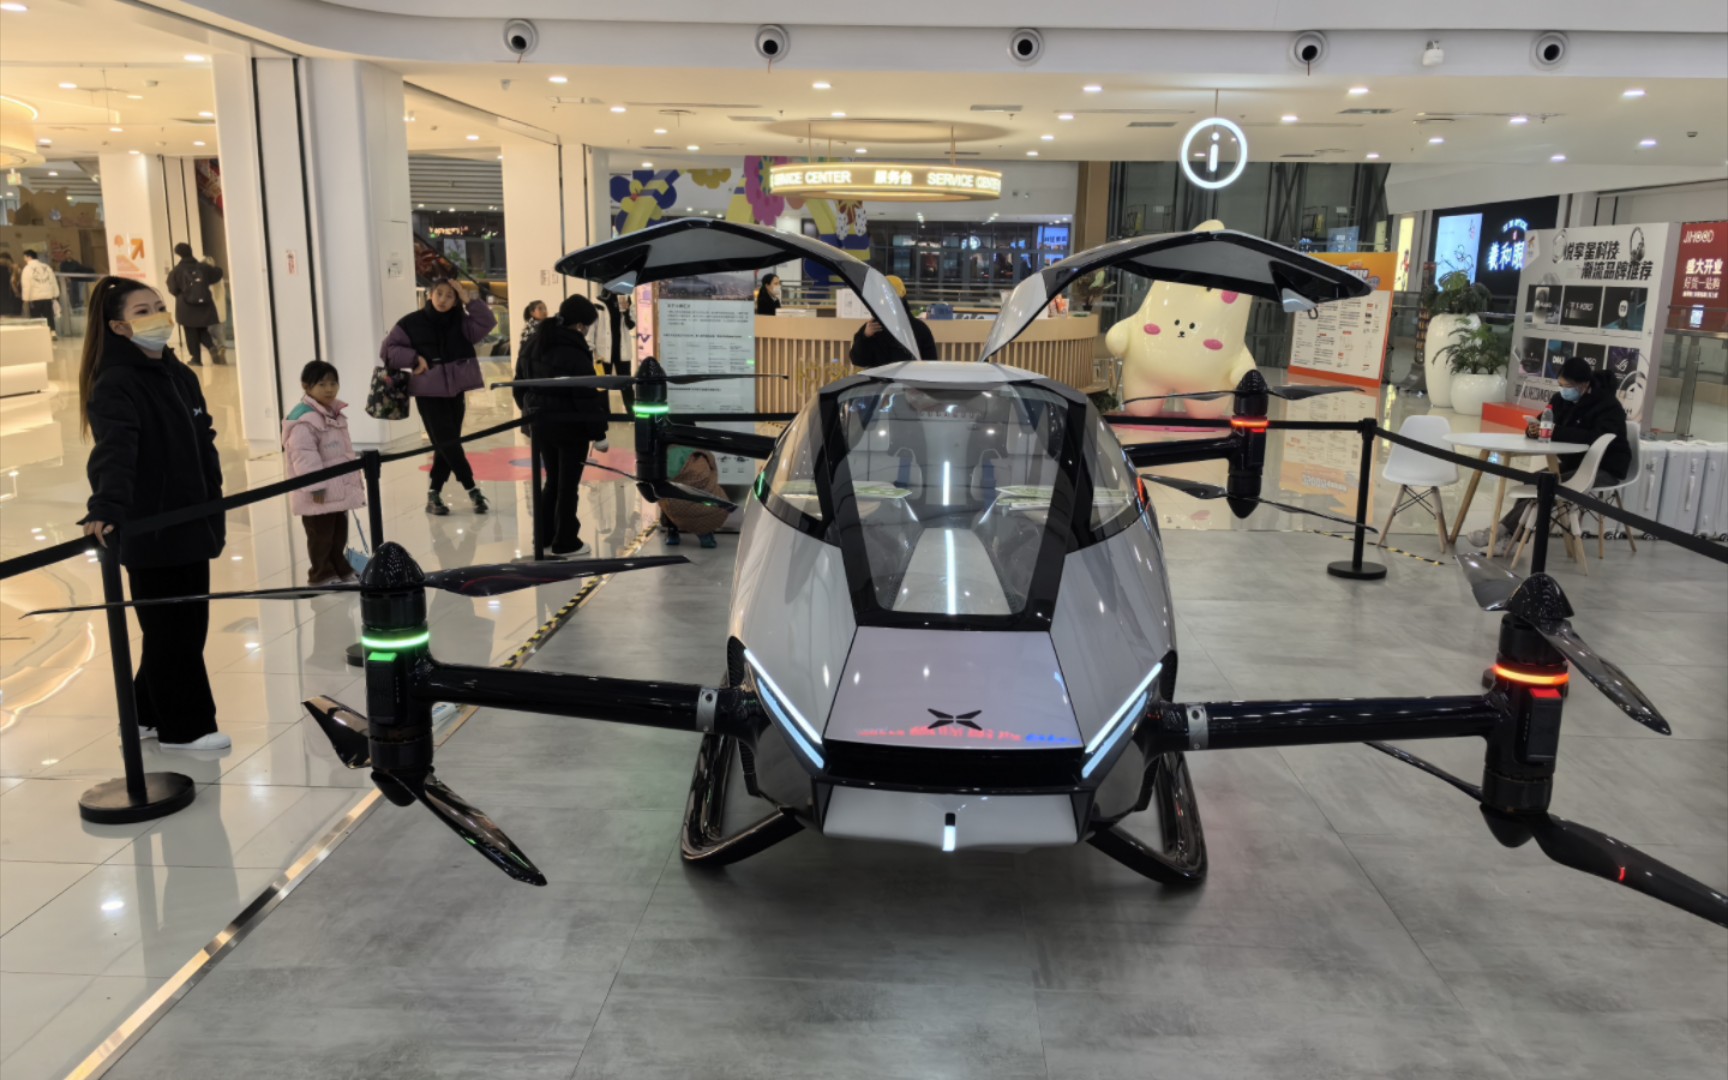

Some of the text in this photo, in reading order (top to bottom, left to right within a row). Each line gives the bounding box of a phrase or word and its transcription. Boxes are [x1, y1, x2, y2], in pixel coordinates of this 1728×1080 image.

[804, 169, 852, 184] CENTER
[874, 168, 912, 185] 服务台
[927, 171, 974, 187] SERVICE
[1581, 261, 1654, 280] 潮流品牌推荐
[1685, 258, 1724, 275] 盛大开业
